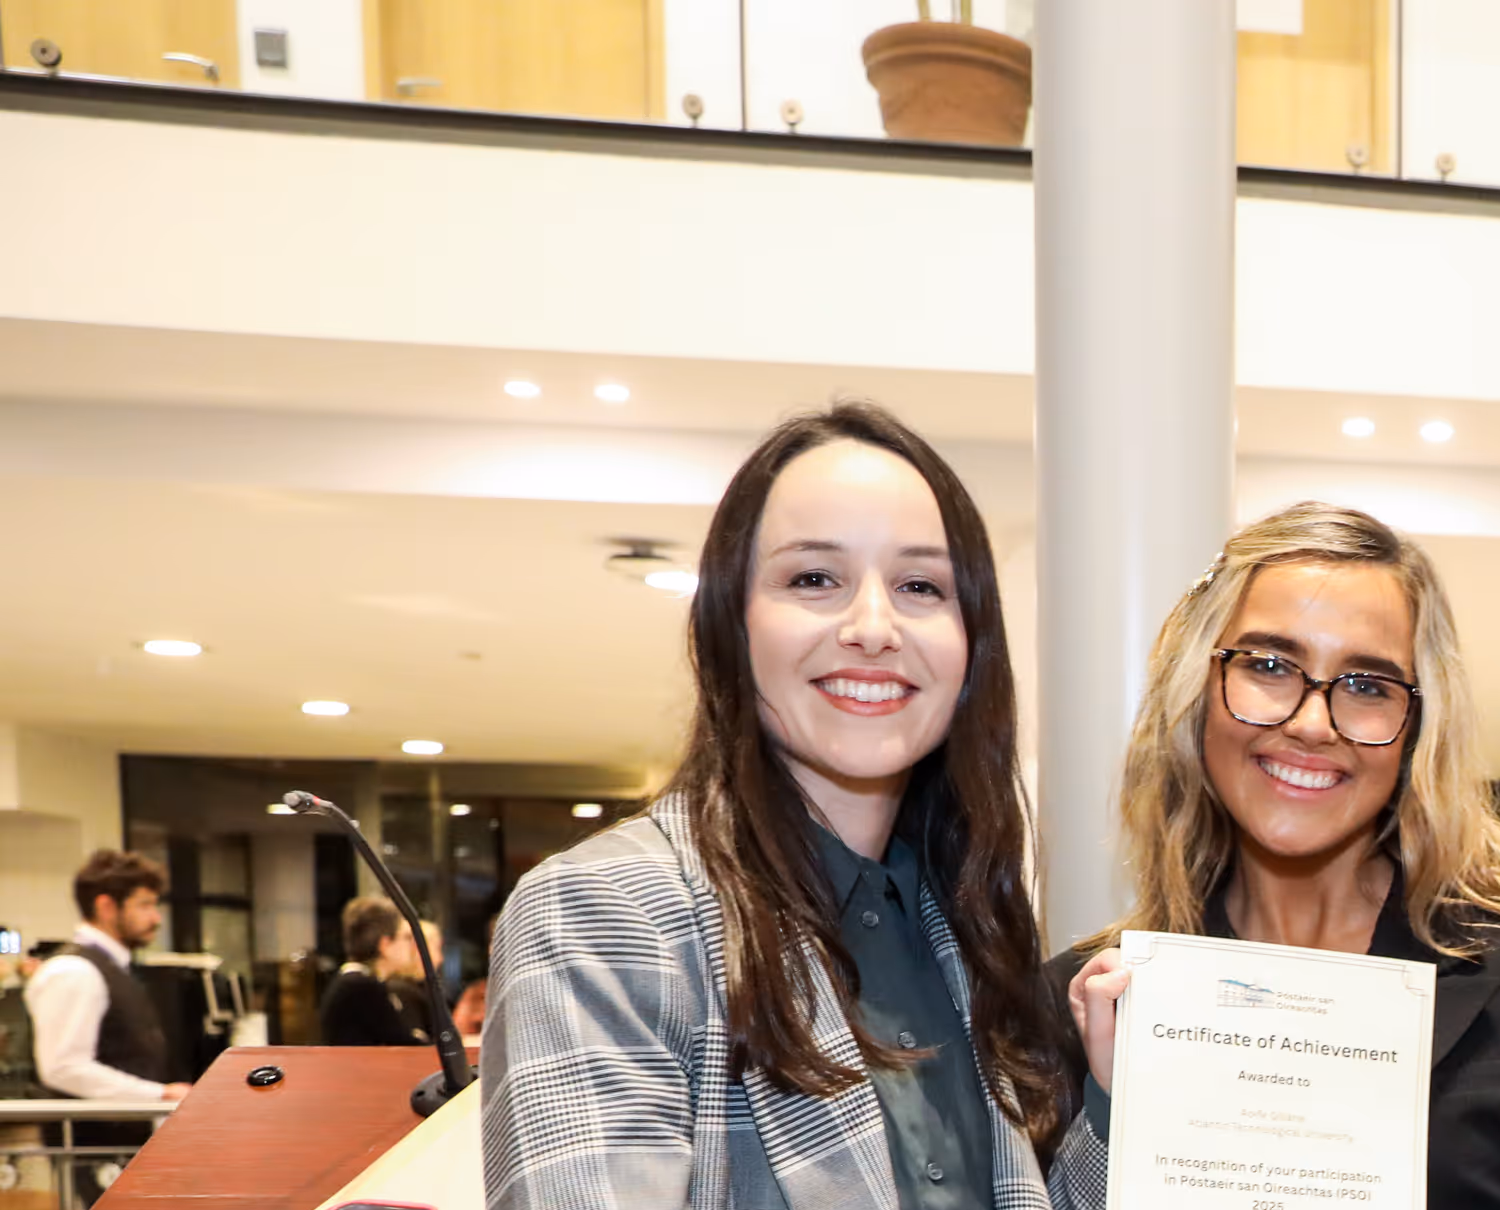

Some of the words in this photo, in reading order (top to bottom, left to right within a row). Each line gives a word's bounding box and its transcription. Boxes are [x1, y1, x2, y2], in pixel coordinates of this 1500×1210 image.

[1152, 1023, 1251, 1047] Certificate
[1256, 1034, 1276, 1049] of
[1279, 1036, 1398, 1063] Achievement
[1237, 1069, 1294, 1085] Awarded
[1296, 1077, 1310, 1087] to
[1155, 1153, 1168, 1165] In
[1171, 1157, 1246, 1172] recognition
[1249, 1162, 1264, 1173] of
[1266, 1166, 1296, 1177] your
[1298, 1168, 1381, 1183] participation
